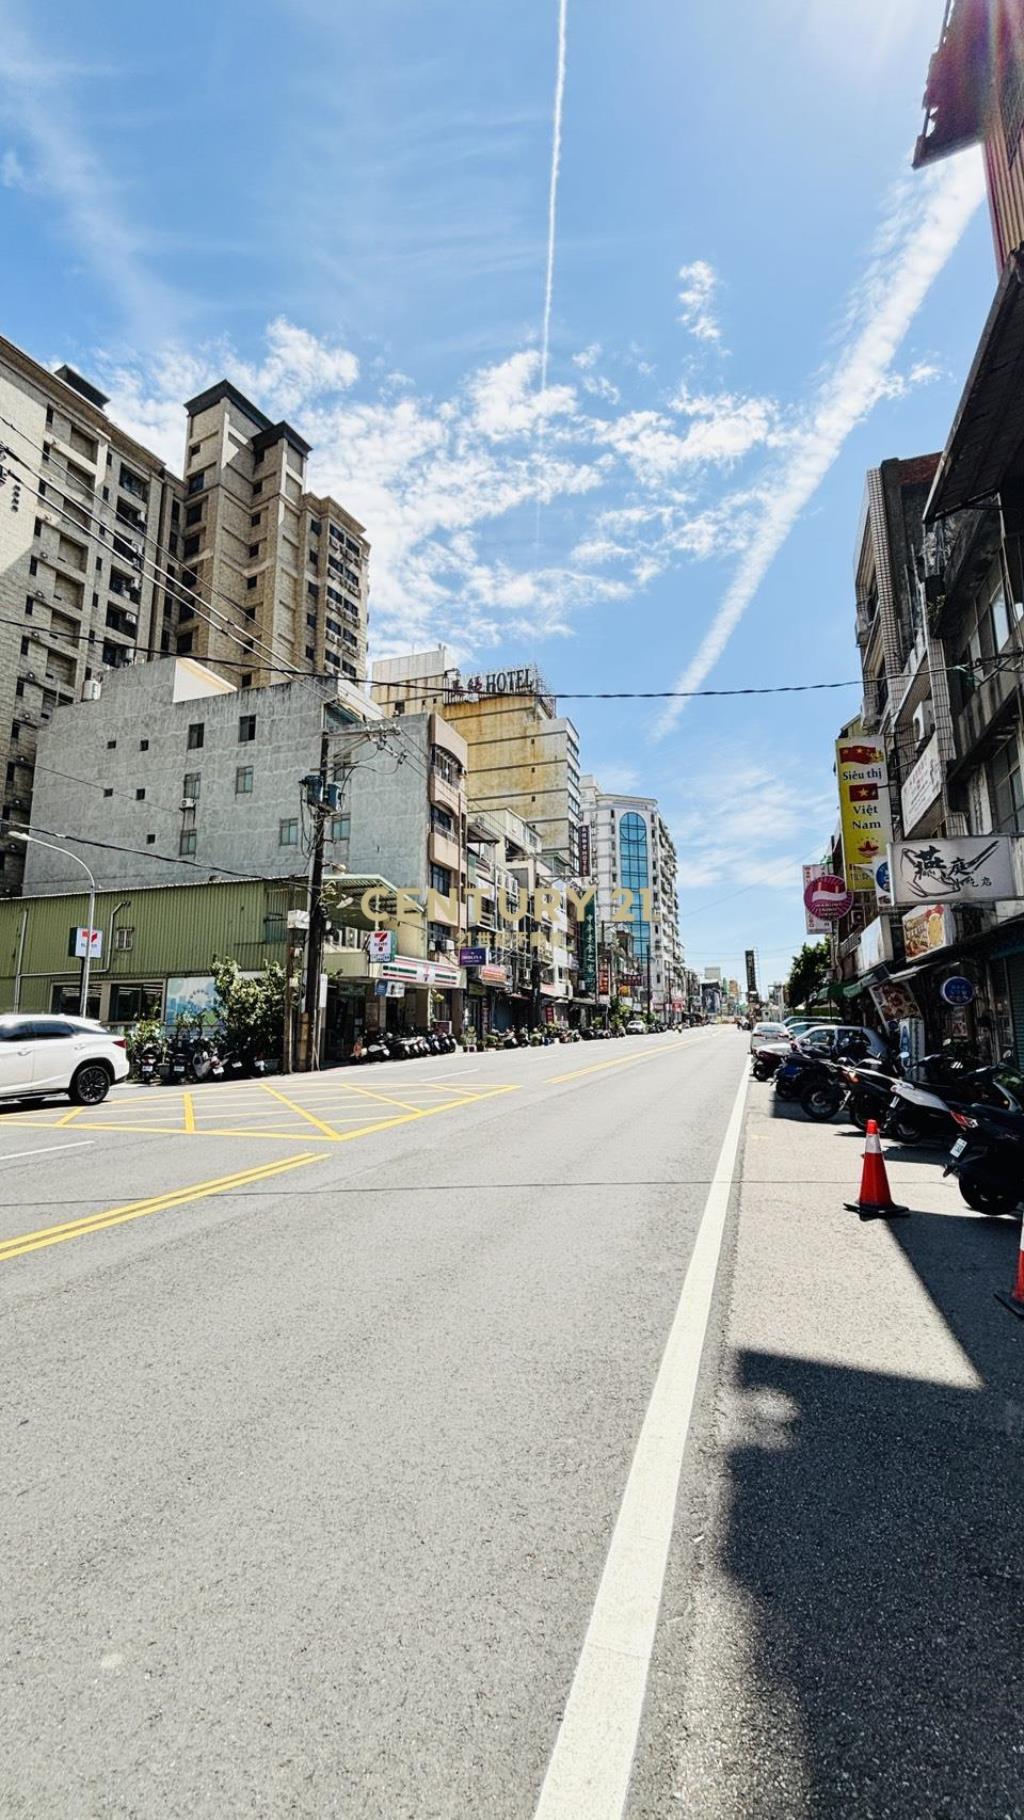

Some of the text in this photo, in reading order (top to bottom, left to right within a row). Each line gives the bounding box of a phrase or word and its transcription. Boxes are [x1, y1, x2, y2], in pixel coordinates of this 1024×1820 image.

[486, 669, 532, 692] HOTEL
[842, 770, 865, 781] Siêu
[853, 804, 879, 816] Việt
[852, 821, 881, 830] Nam
